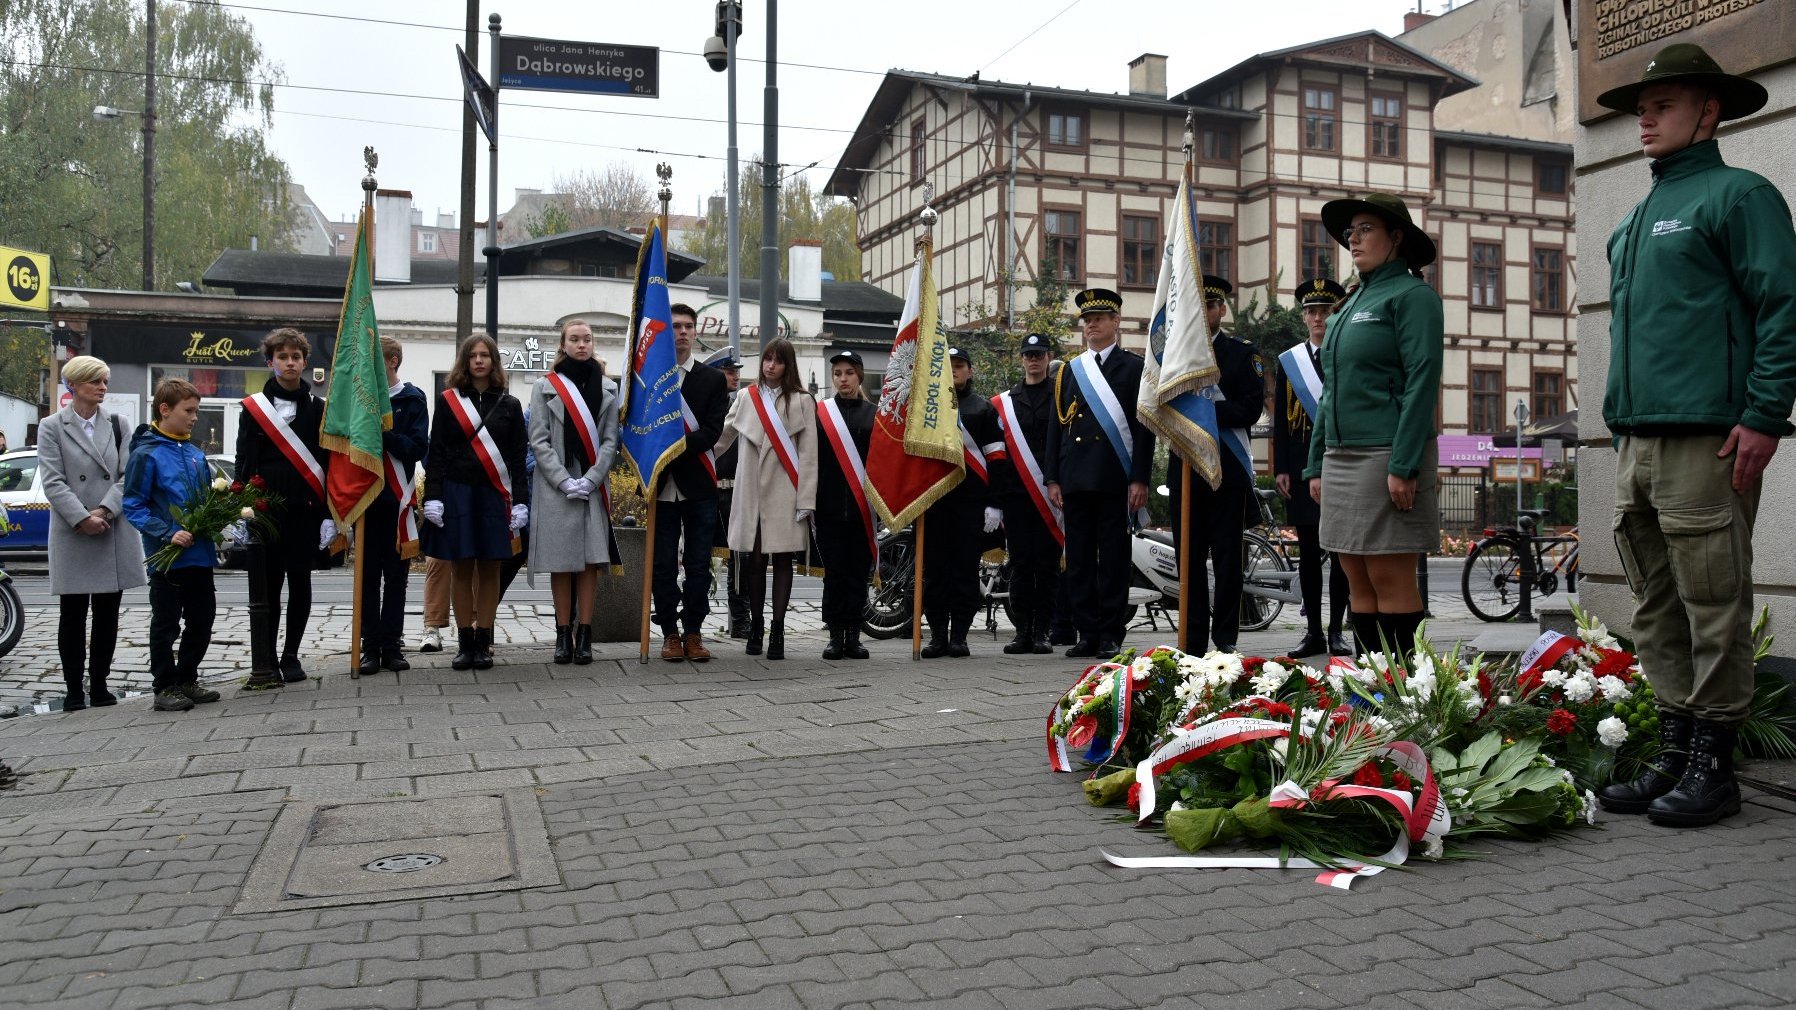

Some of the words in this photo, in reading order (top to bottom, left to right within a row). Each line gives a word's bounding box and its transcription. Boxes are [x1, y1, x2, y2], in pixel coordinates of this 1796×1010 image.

[1642, 13, 1661, 29] OD
[1664, 1, 1693, 21] KULI
[1599, 15, 1692, 58] ROBOTNICZEGO
[533, 43, 556, 53] ulica
[560, 45, 583, 54] Jana
[588, 47, 625, 58] Henryka
[516, 55, 645, 82] Dąbrowskiego
[9, 265, 31, 289] 16
[183, 338, 214, 357] Just
[212, 337, 256, 362] Queen
[653, 409, 682, 428] LICEUM
